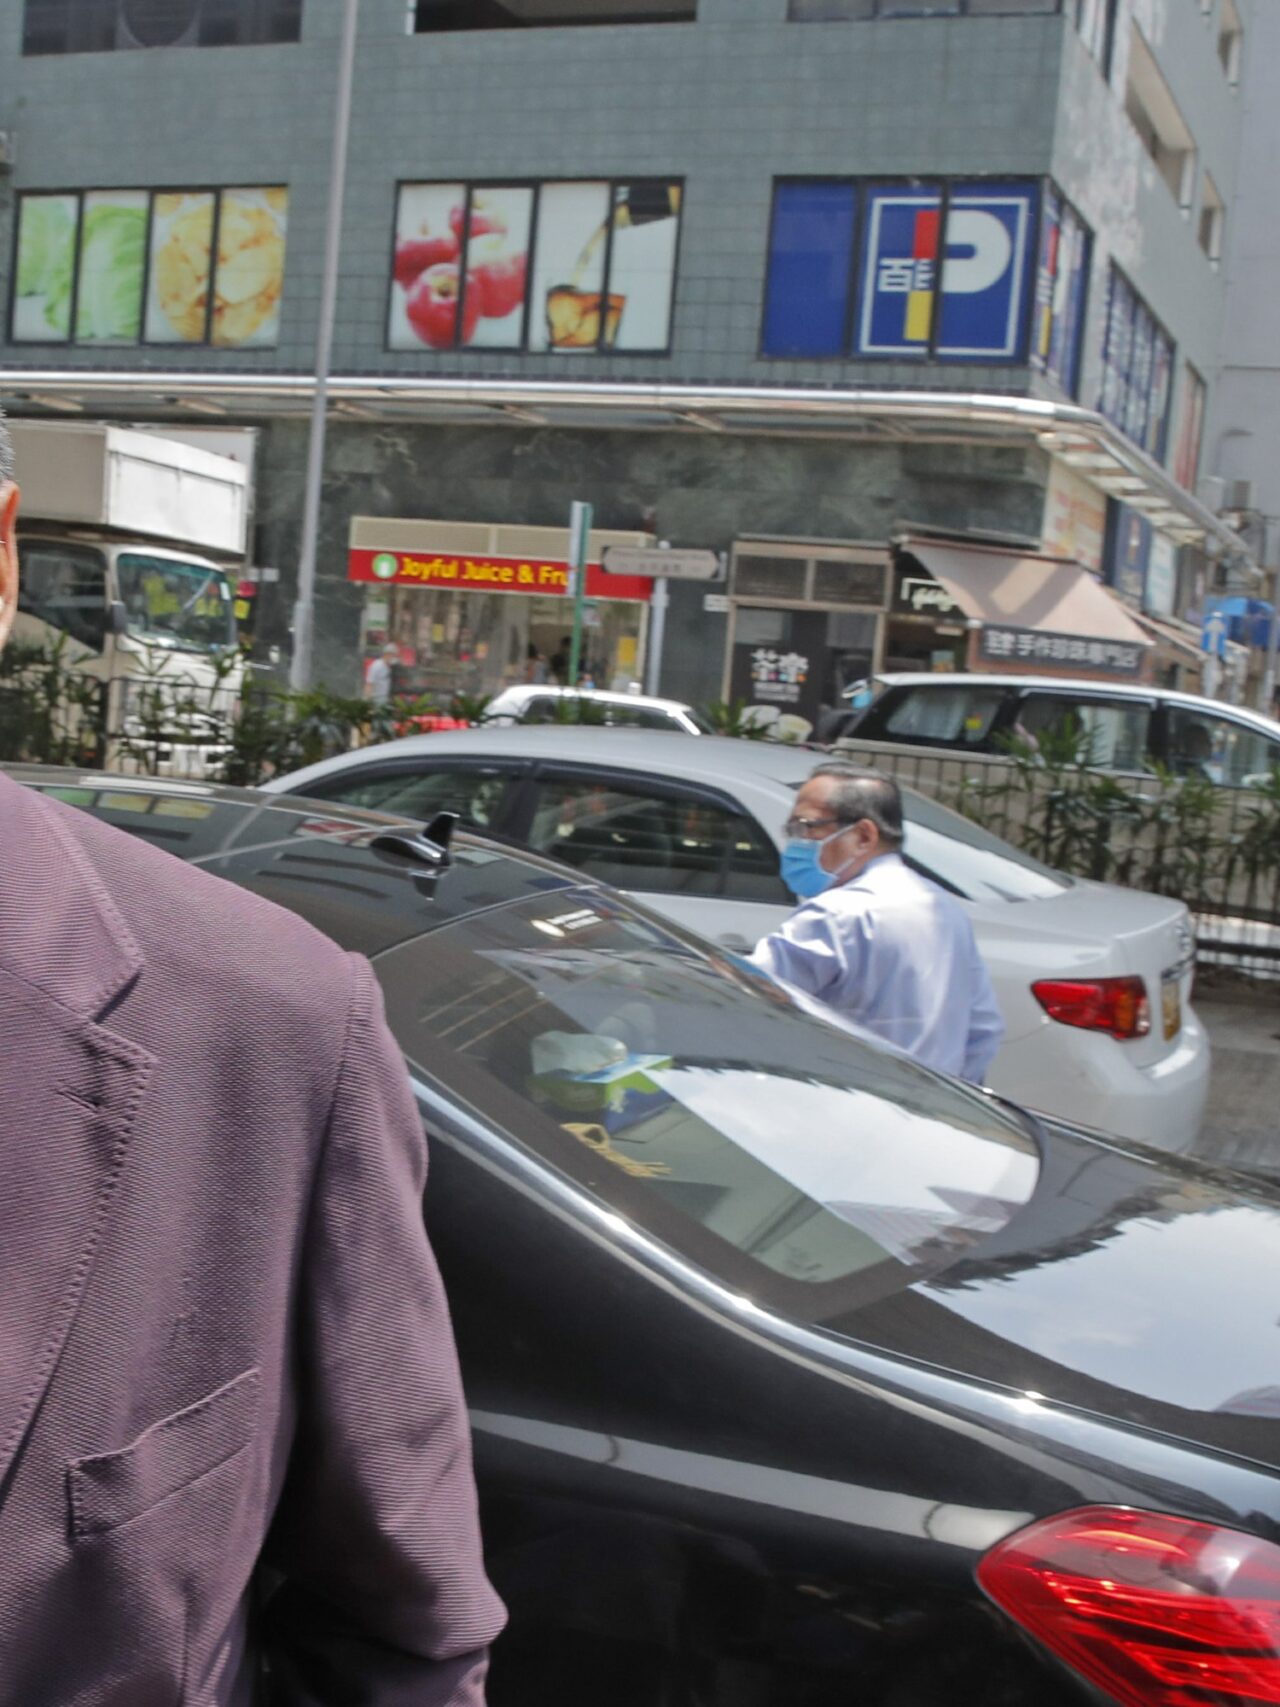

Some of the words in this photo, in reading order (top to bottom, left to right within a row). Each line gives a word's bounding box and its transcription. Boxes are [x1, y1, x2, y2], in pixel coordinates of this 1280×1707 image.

[400, 556, 460, 581] Joyful
[462, 560, 514, 583] Juice
[517, 563, 535, 584] &
